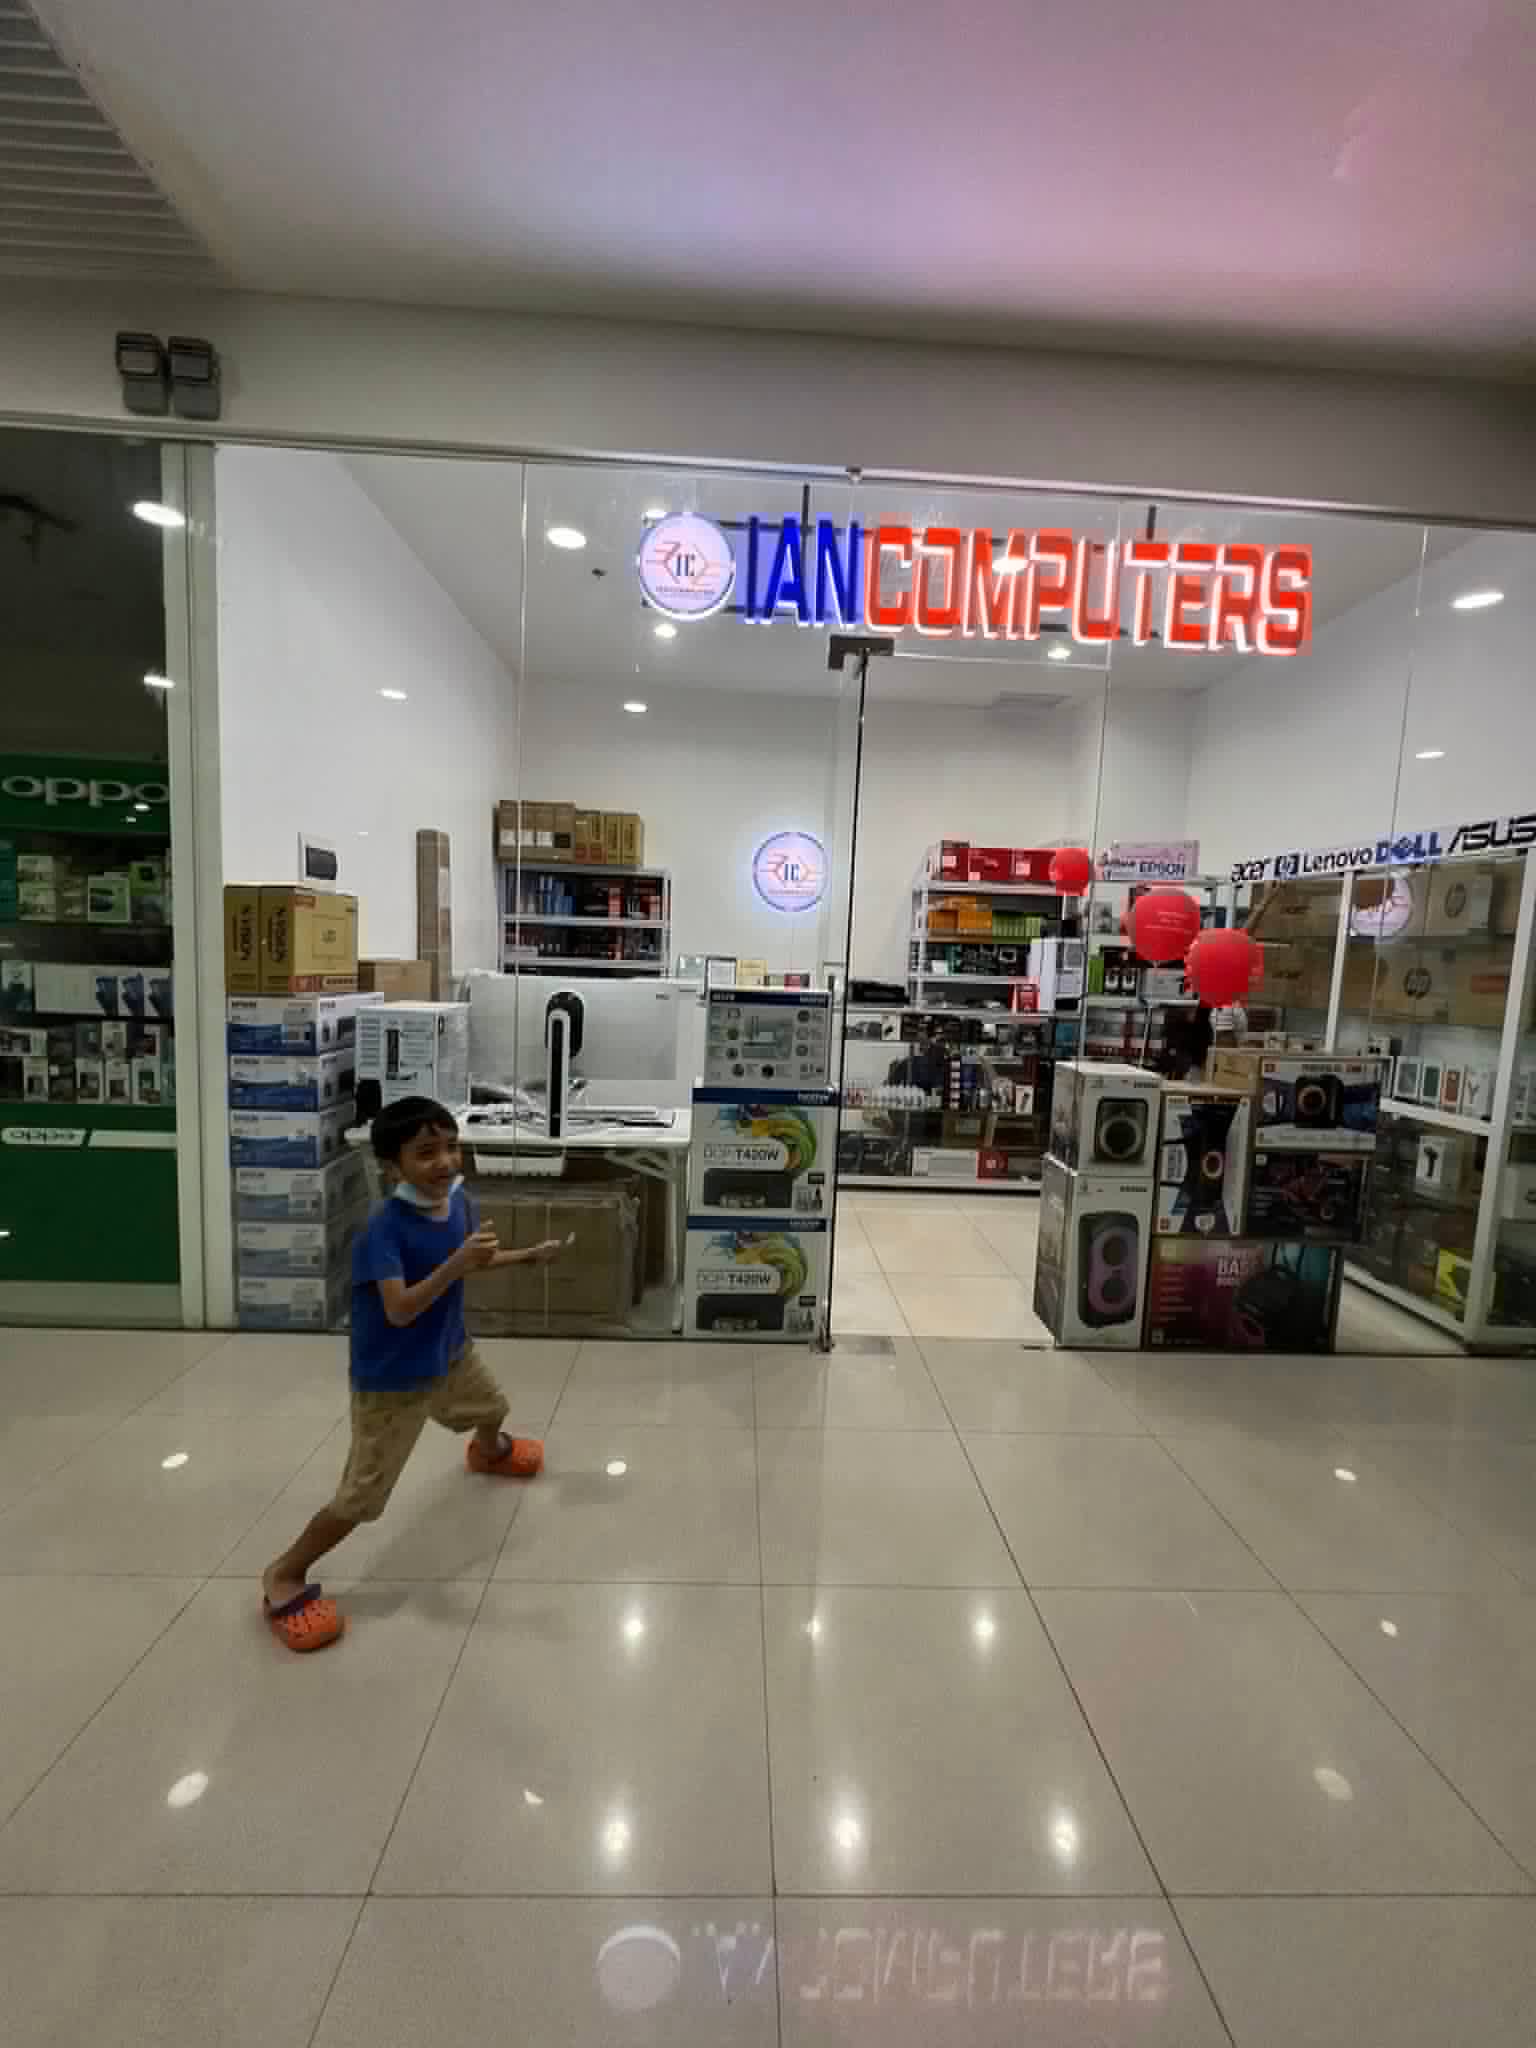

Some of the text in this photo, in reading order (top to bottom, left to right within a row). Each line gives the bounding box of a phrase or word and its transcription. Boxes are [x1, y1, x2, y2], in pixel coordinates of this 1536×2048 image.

[1302, 845, 1374, 873] Lenovo
[1375, 831, 1442, 863] DELL
[1448, 812, 1536, 854] ASUS
